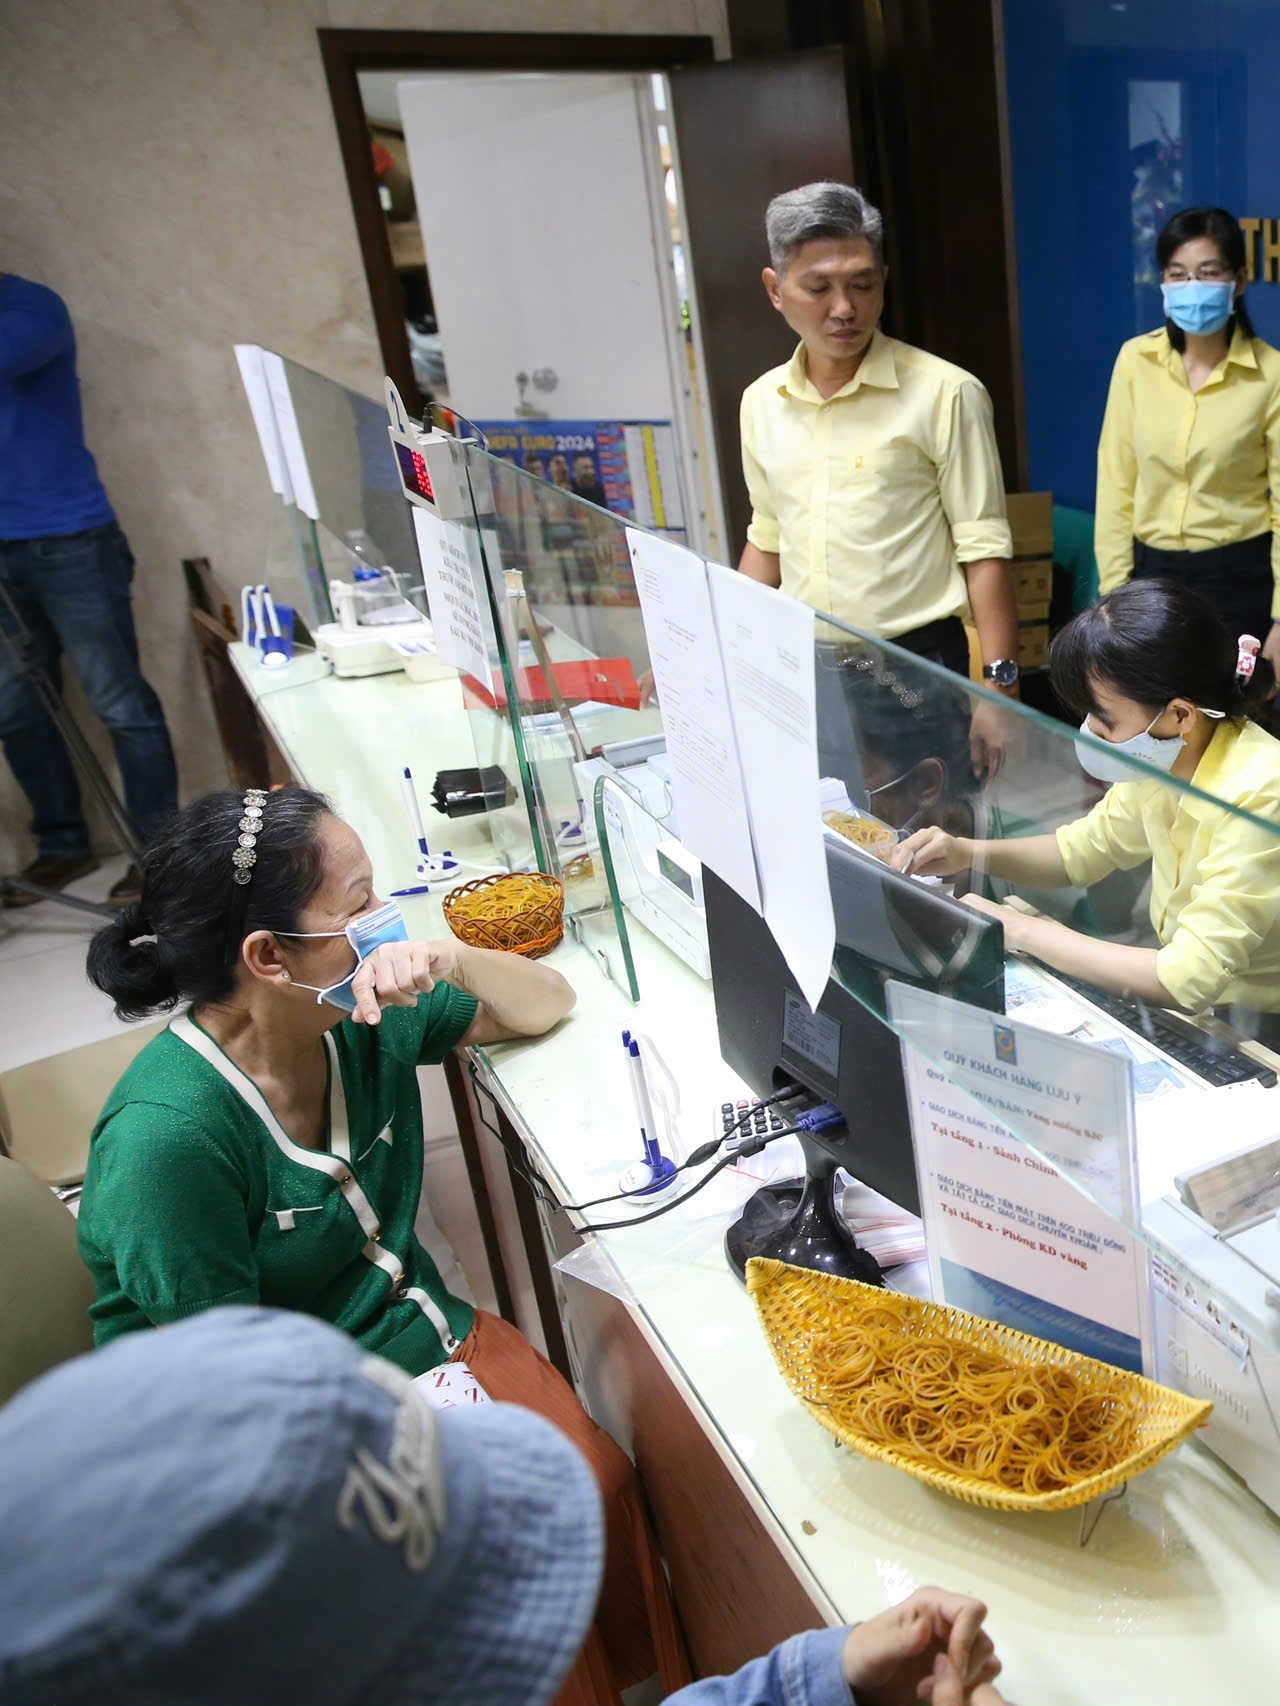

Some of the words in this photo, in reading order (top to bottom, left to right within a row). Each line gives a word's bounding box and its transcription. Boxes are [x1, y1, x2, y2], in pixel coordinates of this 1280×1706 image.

[555, 434, 595, 451] 2024
[943, 1050, 966, 1067] QUÝ
[970, 1057, 1007, 1081] KHÁCH
[1011, 1071, 1042, 1093] HÀNG
[928, 1101, 946, 1115] GIAO
[930, 1121, 947, 1138] Tại
[951, 1130, 975, 1150] tầng
[993, 1145, 1021, 1164] Sảnh
[1024, 1156, 1059, 1178] Chính
[937, 1172, 954, 1187] GIAO
[956, 1179, 973, 1194] DỊCH
[1015, 1203, 1034, 1219] MẶT
[1037, 1210, 1057, 1226] TRÊN
[940, 1202, 958, 1218] Tại
[960, 1209, 984, 1230] tầng
[985, 1221, 993, 1232] 2
[1002, 1226, 1037, 1250] Phòng
[1039, 1240, 1058, 1256] KD
[1060, 1250, 1088, 1271] vàng
[433, 1372, 451, 1388] Z
